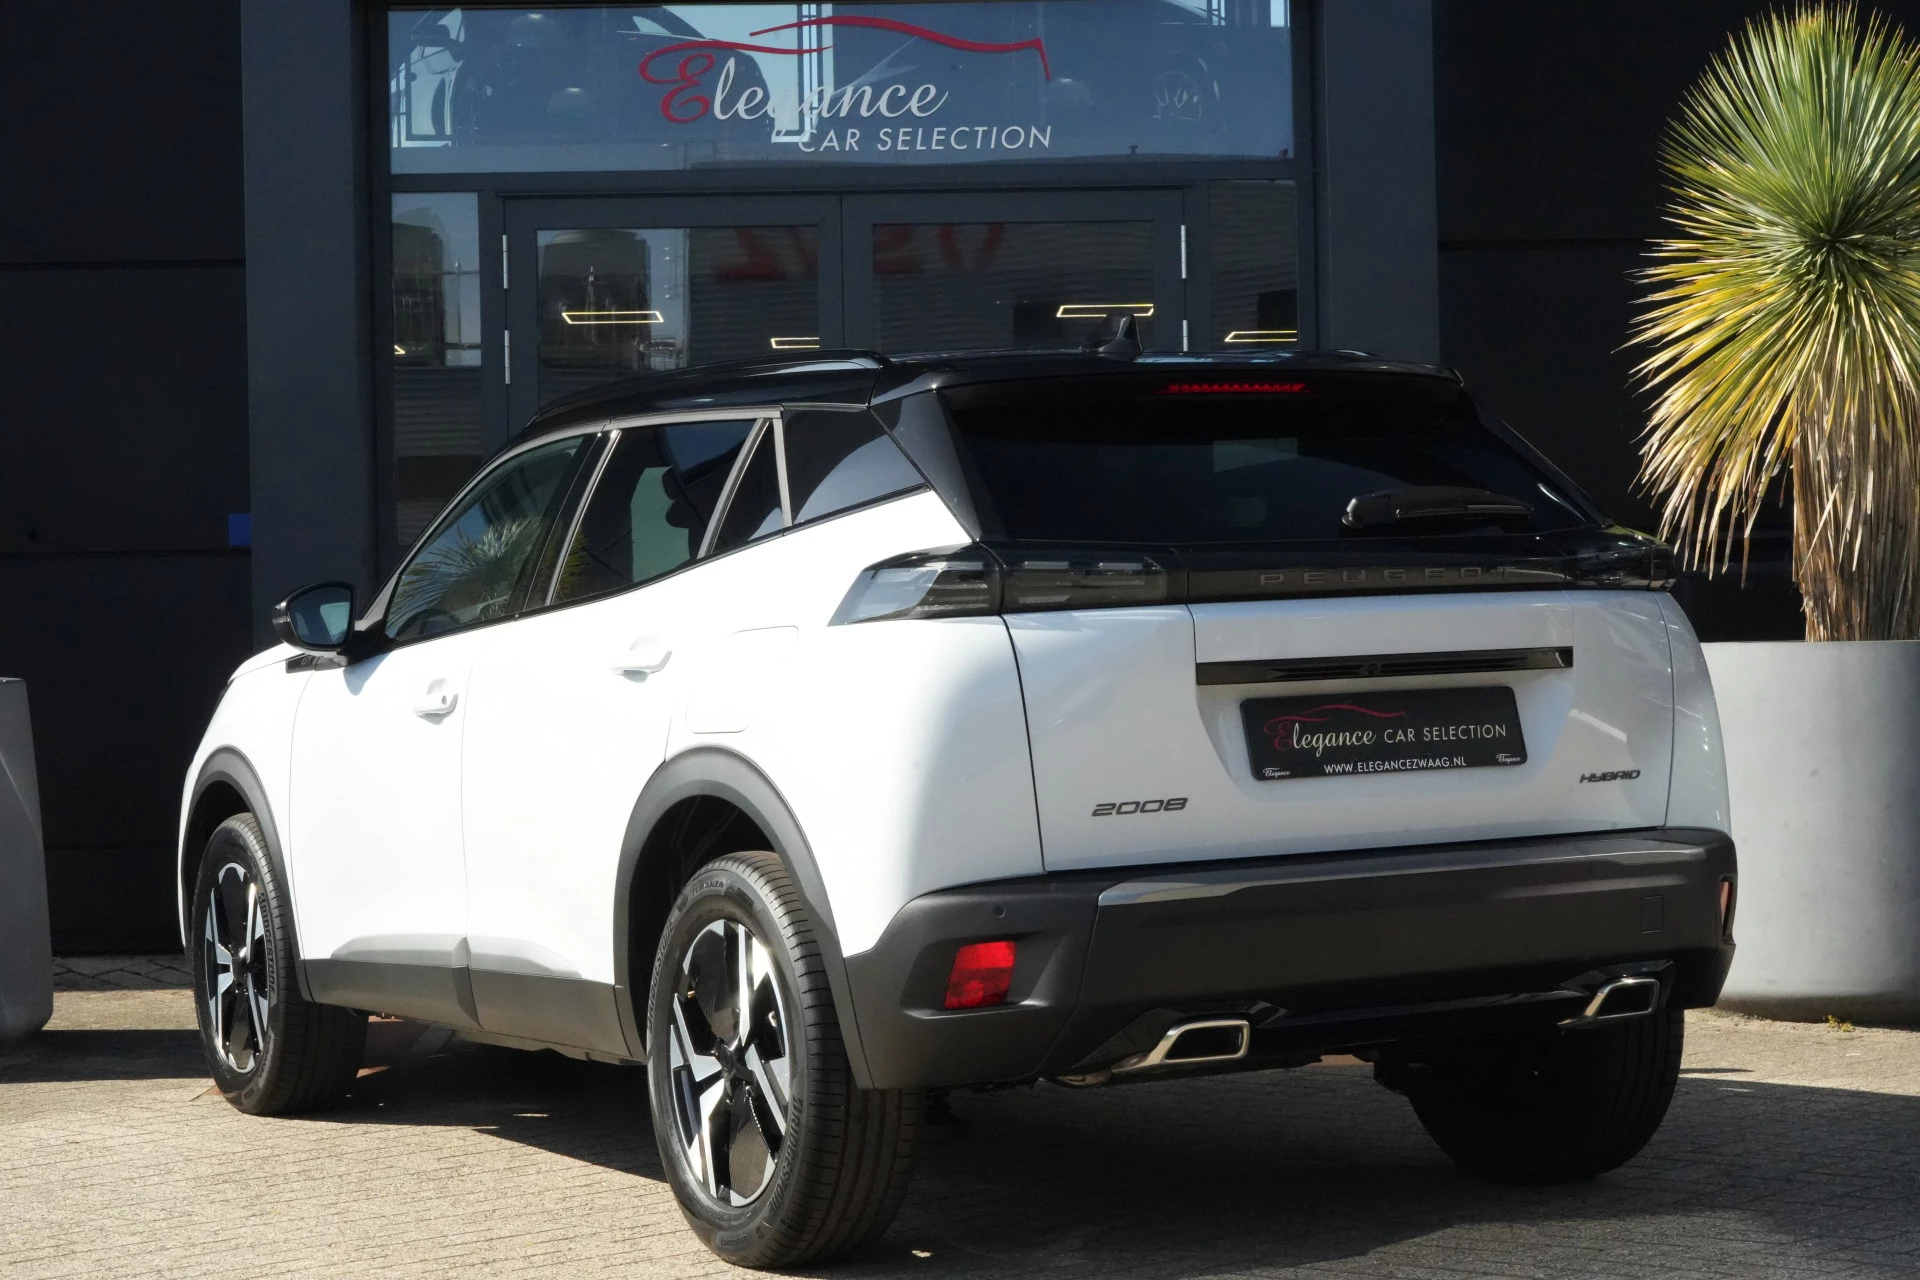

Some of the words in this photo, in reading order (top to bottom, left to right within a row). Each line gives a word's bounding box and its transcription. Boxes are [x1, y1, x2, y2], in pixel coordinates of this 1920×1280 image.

[798, 128, 860, 153] CAR
[877, 126, 1052, 151] SELECTION
[1259, 566, 1516, 586] PEUGEOT
[1264, 716, 1376, 757] Elegance
[1384, 729, 1415, 743] CAR
[1424, 724, 1506, 741] SELECTION
[1323, 757, 1466, 774] WWW.ELEGANCEZWAAG.NL
[1579, 769, 1641, 783] HYBRID
[1092, 797, 1188, 817] 2008
